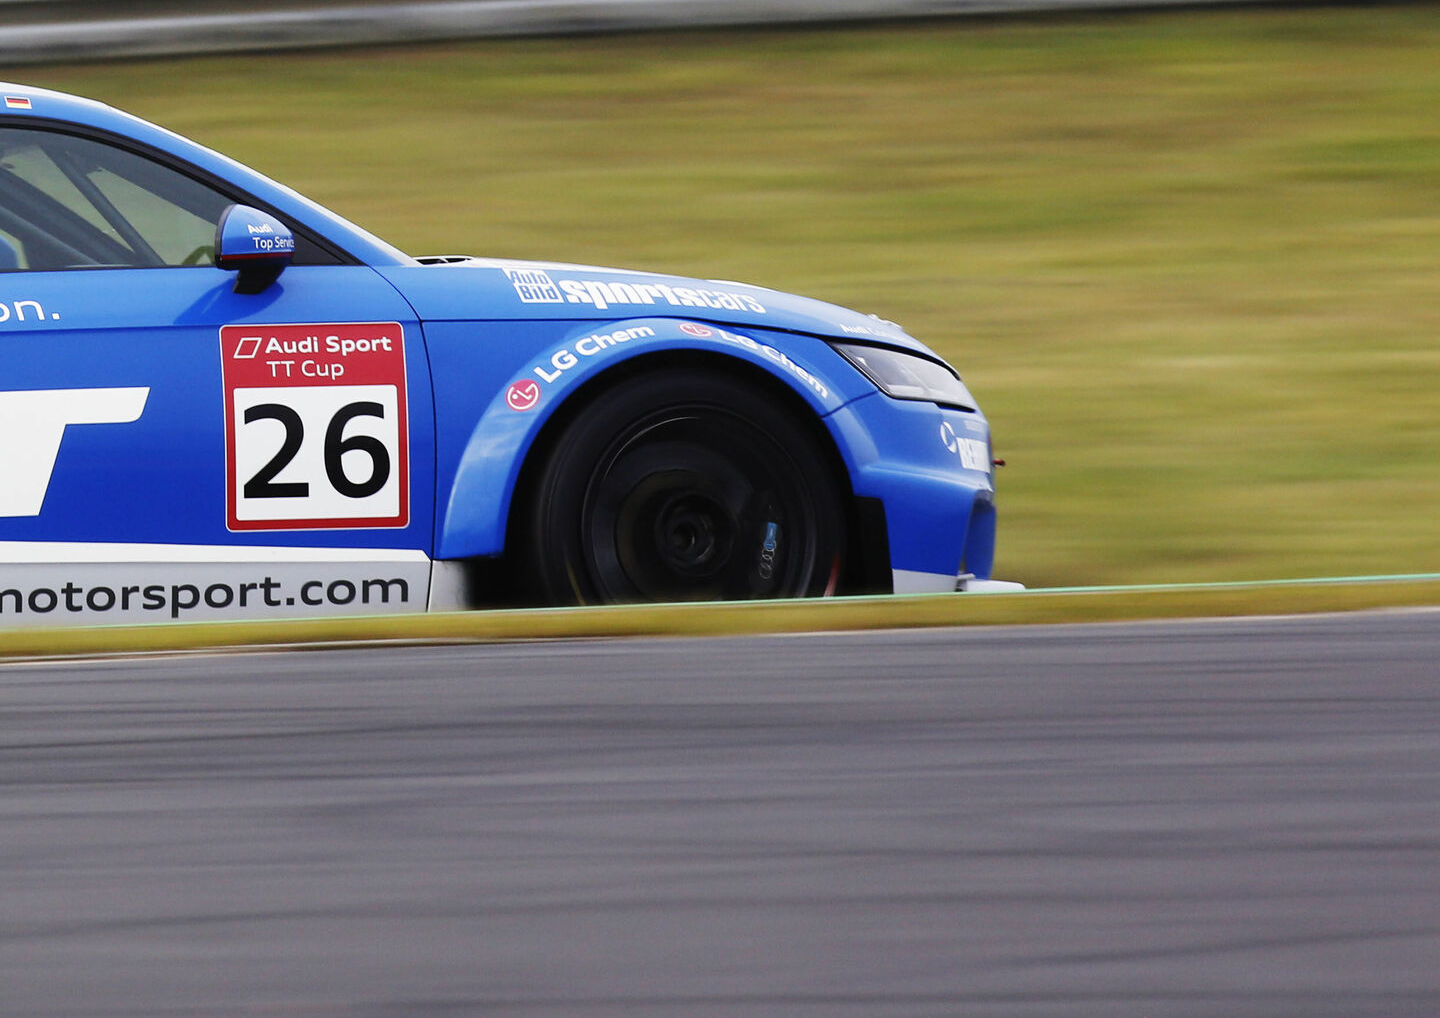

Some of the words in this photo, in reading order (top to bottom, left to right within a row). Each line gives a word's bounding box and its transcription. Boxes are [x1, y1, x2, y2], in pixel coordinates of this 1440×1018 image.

[247, 223, 274, 234] Audi
[252, 237, 273, 251] Top
[511, 270, 548, 285] Auto
[521, 284, 558, 301] Bild
[558, 279, 766, 314] sportscars
[265, 336, 319, 354] Audi
[325, 335, 393, 356] Sport
[533, 349, 579, 384] LG
[575, 326, 655, 357] Chem
[266, 360, 295, 378] TT
[301, 360, 345, 381] Cup
[716, 329, 767, 356] LG
[763, 348, 829, 399] Chem
[243, 401, 391, 499] 26
